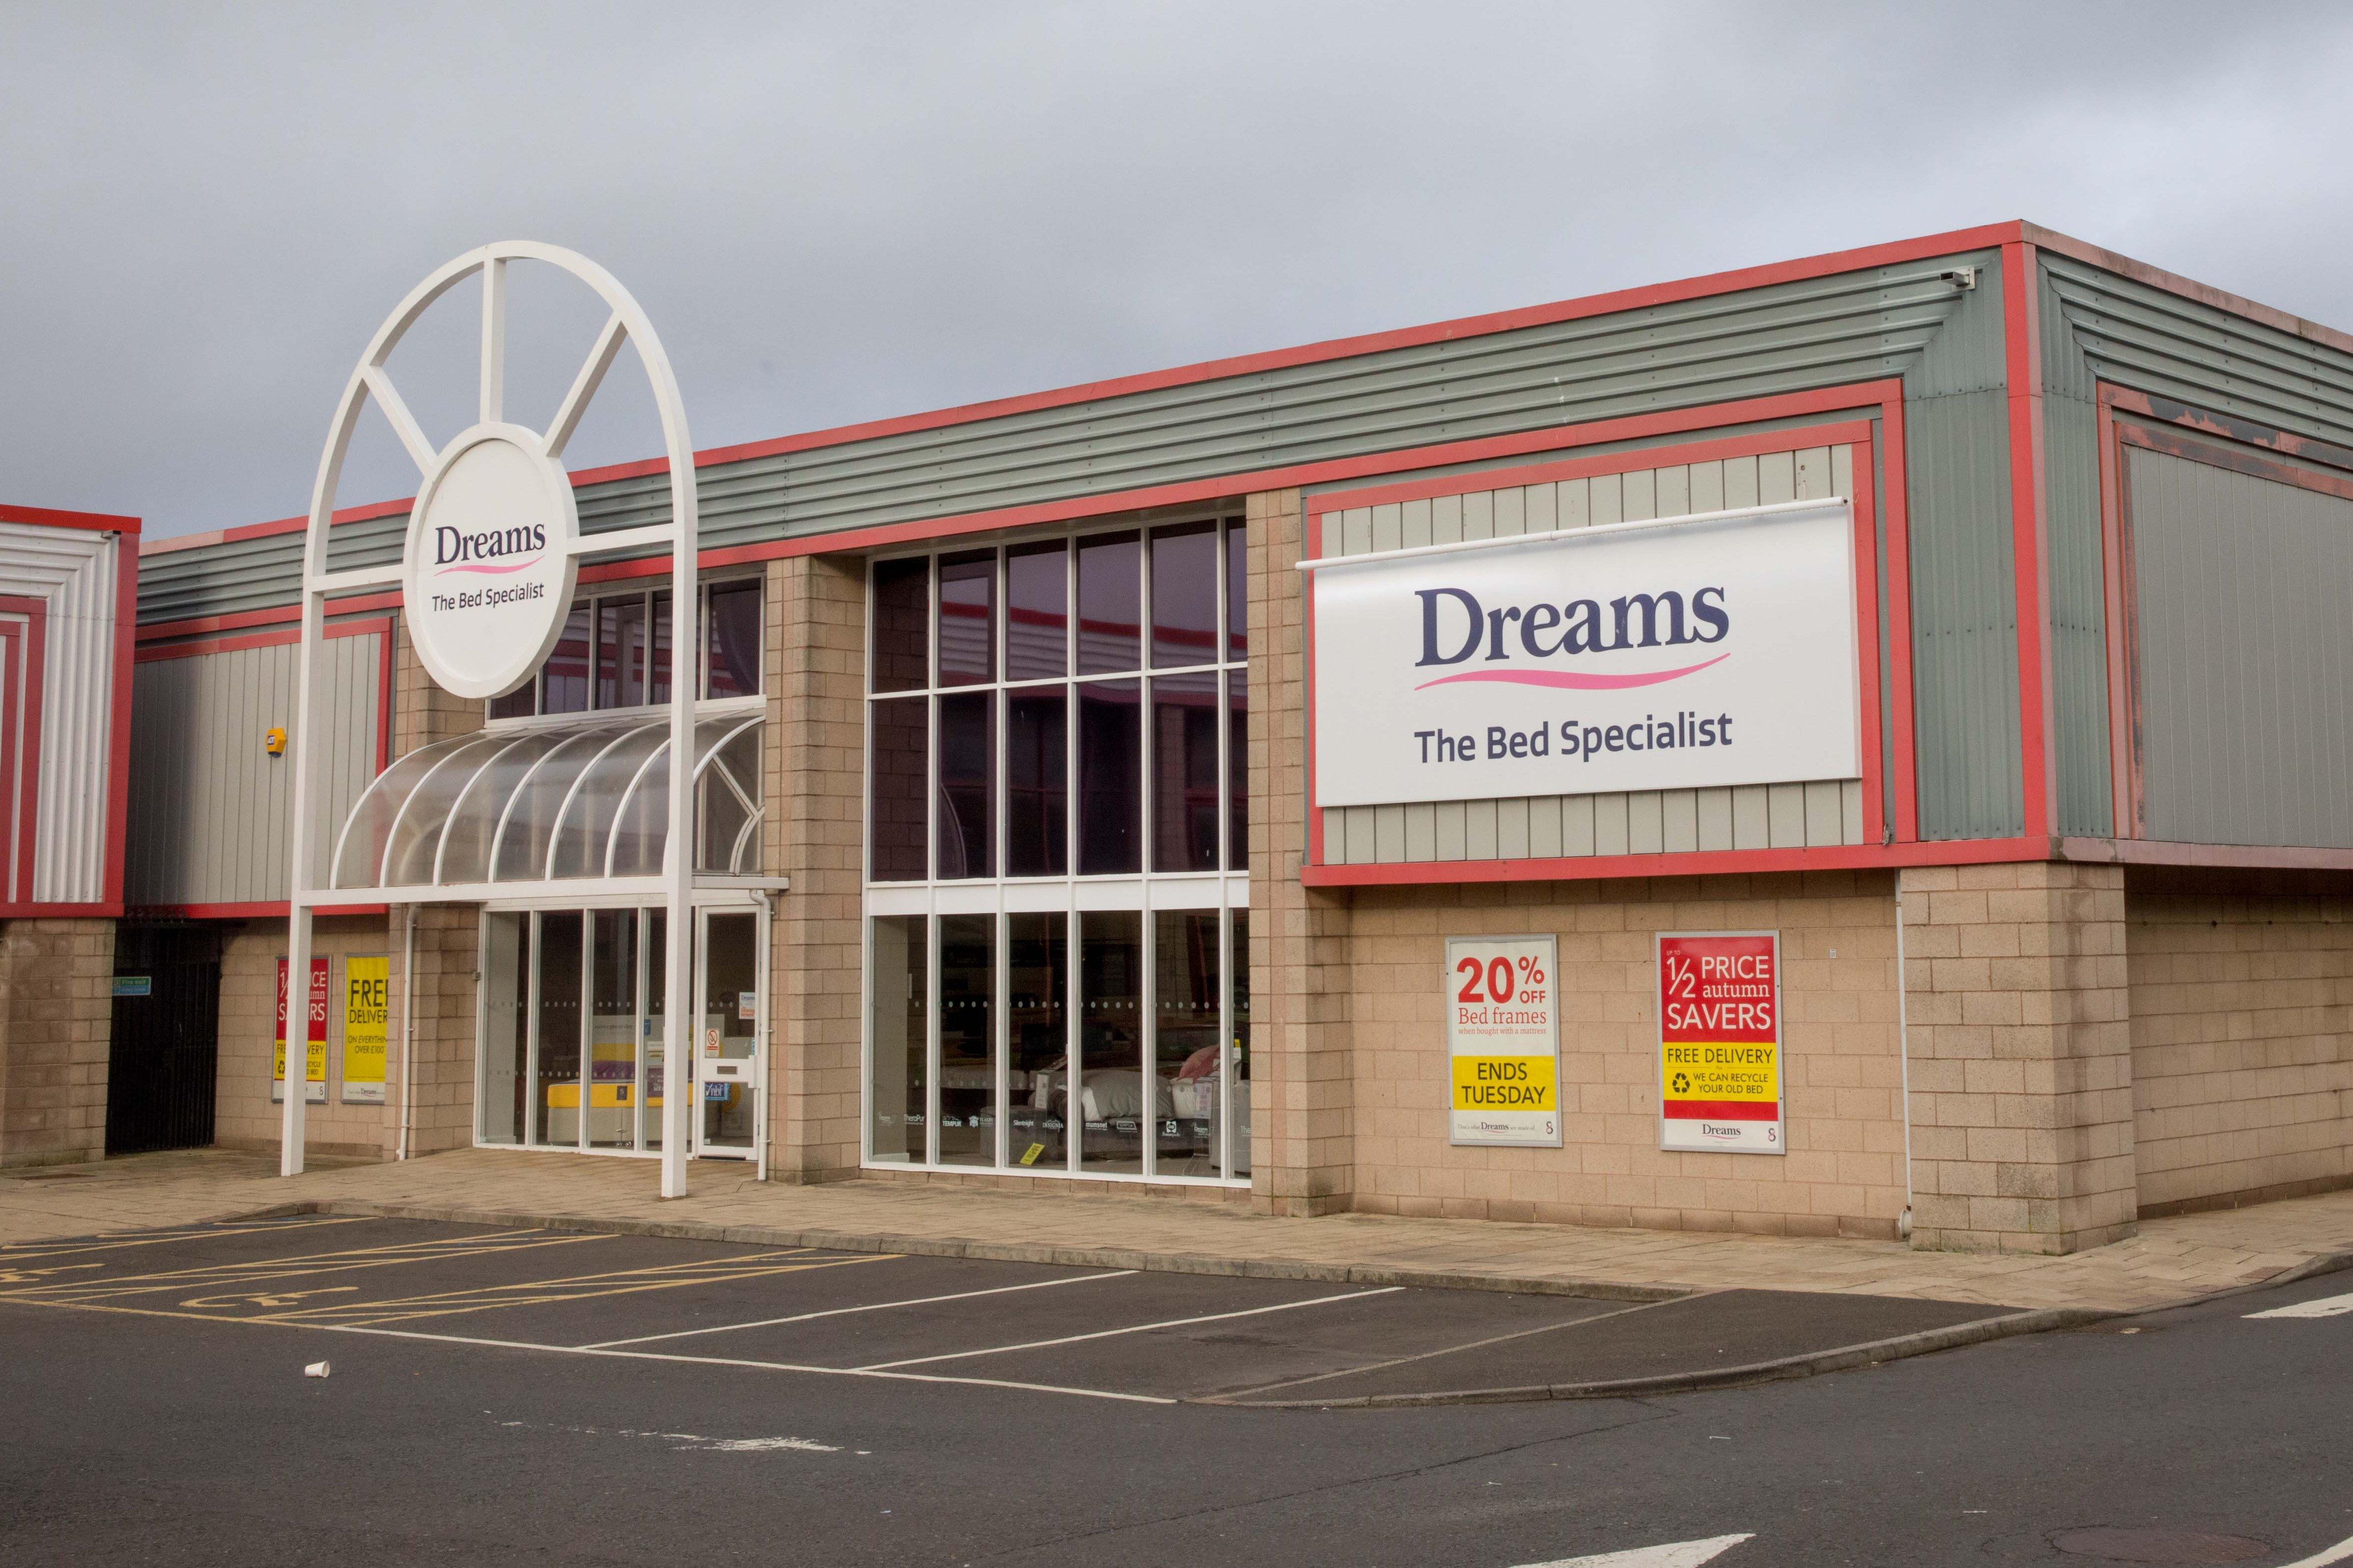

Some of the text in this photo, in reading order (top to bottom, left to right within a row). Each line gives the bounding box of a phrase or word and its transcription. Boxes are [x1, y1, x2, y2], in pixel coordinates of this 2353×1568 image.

[435, 523, 545, 565] Dreams
[432, 582, 544, 611] The Bed Specialist
[1415, 587, 1730, 667] Dreams
[1415, 711, 1732, 763] The Bed Specialist
[1702, 956, 1769, 978] PRICE
[1520, 990, 1545, 1004] OFF
[1703, 982, 1770, 997] autumn
[350, 1010, 387, 1024] DELIVER
[1458, 1007, 1546, 1024] Bed frames
[1668, 1003, 1771, 1029] SAVERS
[1477, 1027, 1498, 1037] bought
[1668, 1048, 1773, 1063] FREE DELIVERY
[1478, 1062, 1527, 1080] ENDS
[1731, 1073, 1768, 1082] RECYCLE
[1461, 1086, 1545, 1104] TUESDAY
[1725, 1085, 1743, 1093] OLD
[1746, 1085, 1763, 1094] BED
[1703, 1124, 1741, 1135] Dreams
